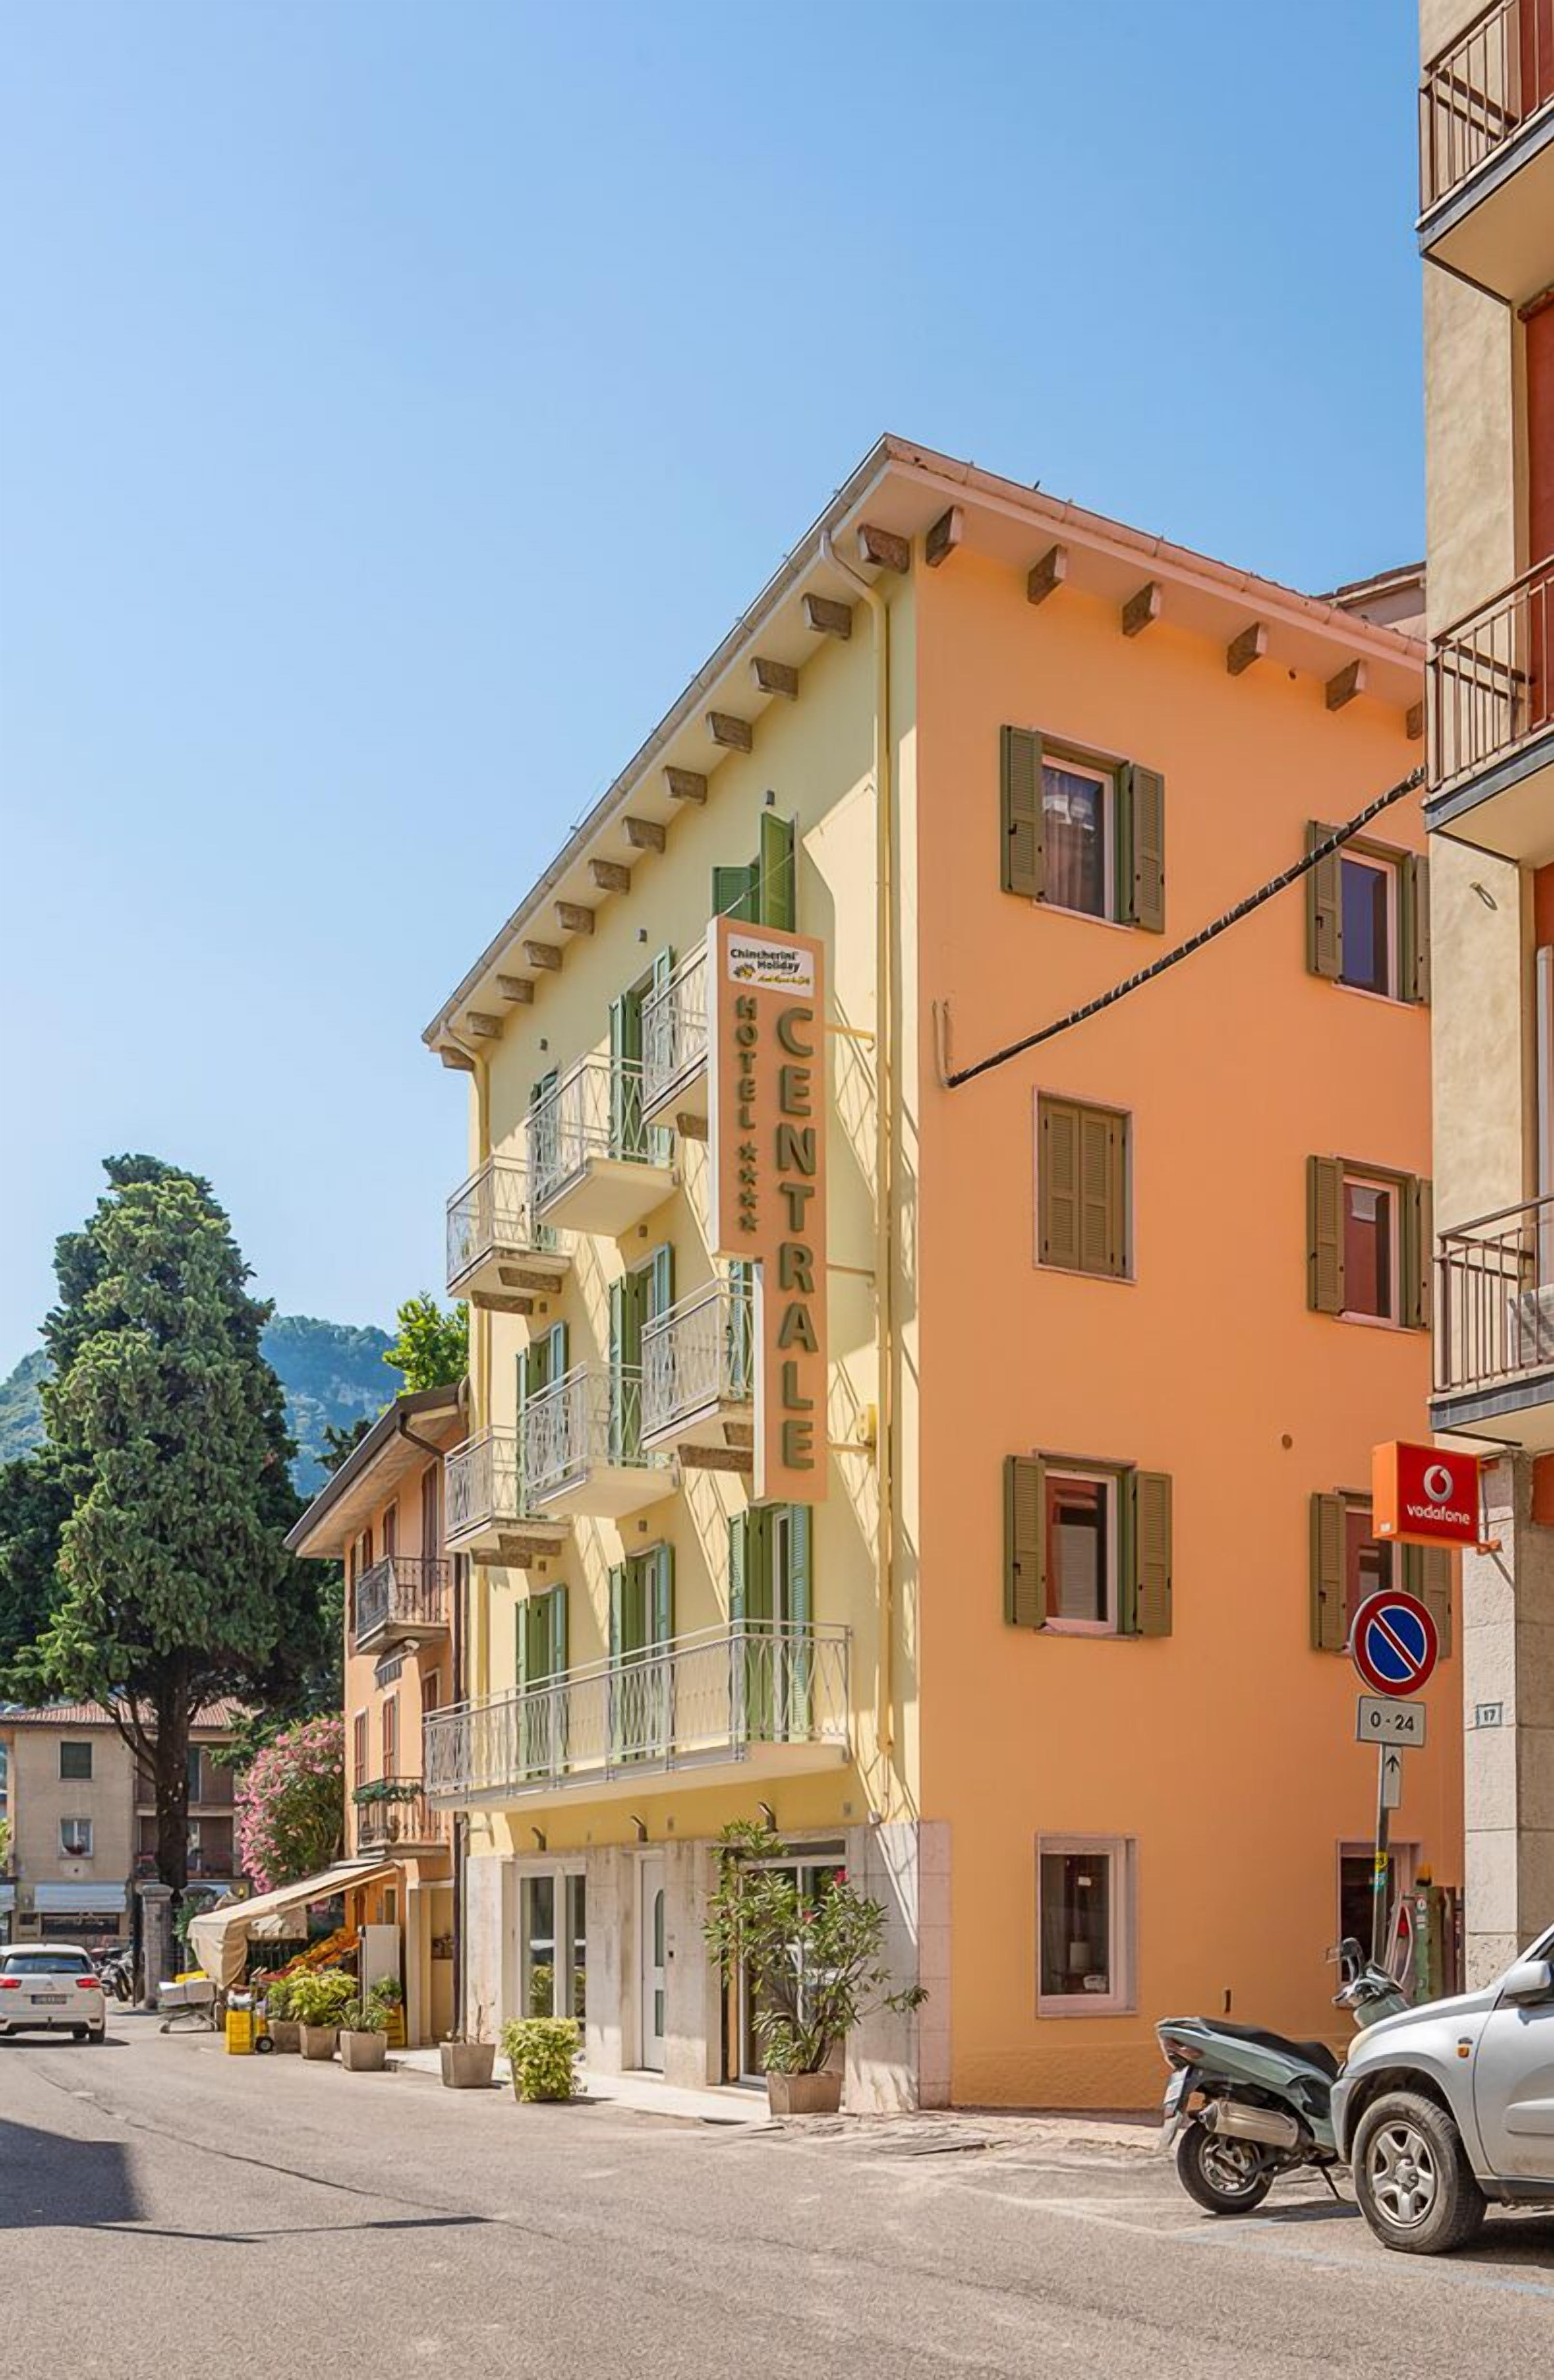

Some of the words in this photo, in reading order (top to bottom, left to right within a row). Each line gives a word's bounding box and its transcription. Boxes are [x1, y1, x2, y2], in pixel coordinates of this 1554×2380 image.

[757, 960, 800, 973] Holiday
[736, 995, 758, 1130] HOTEL
[777, 1007, 818, 1470] CENTRALE
[1407, 1504, 1470, 1525] vodafone
[1395, 1714, 1414, 1731] 24
[1484, 1709, 1496, 1721] 17
